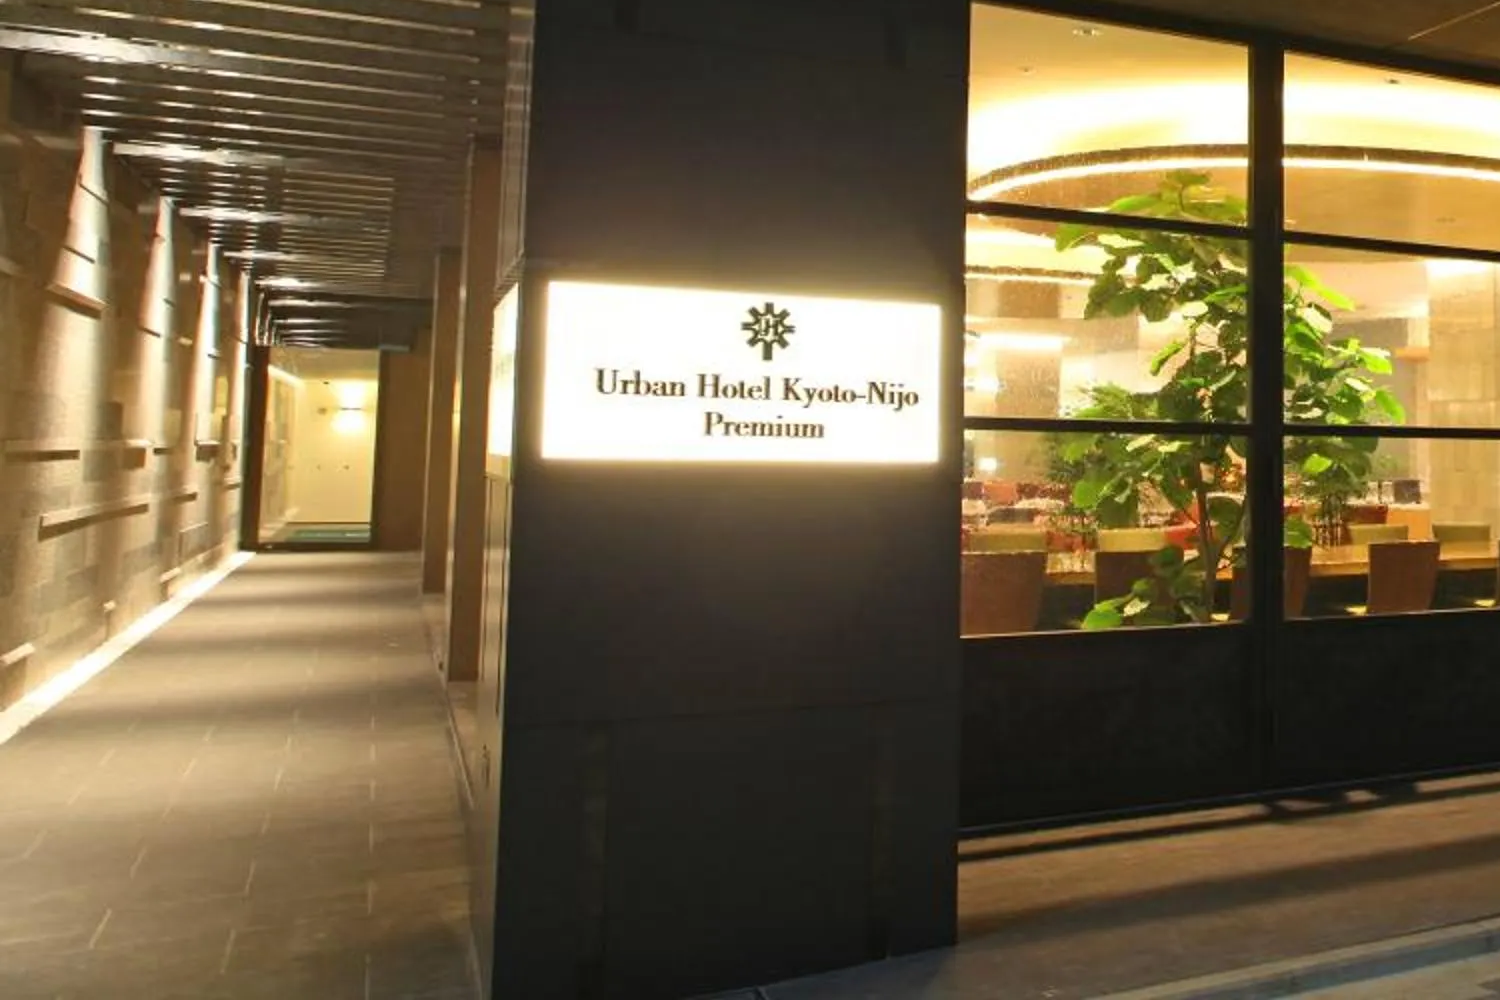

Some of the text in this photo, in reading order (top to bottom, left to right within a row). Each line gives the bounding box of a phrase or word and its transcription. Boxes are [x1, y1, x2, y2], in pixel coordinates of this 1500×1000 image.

[595, 368, 919, 411] Urban Hotel Kyoto-Nijo
[704, 411, 825, 439] Premium
